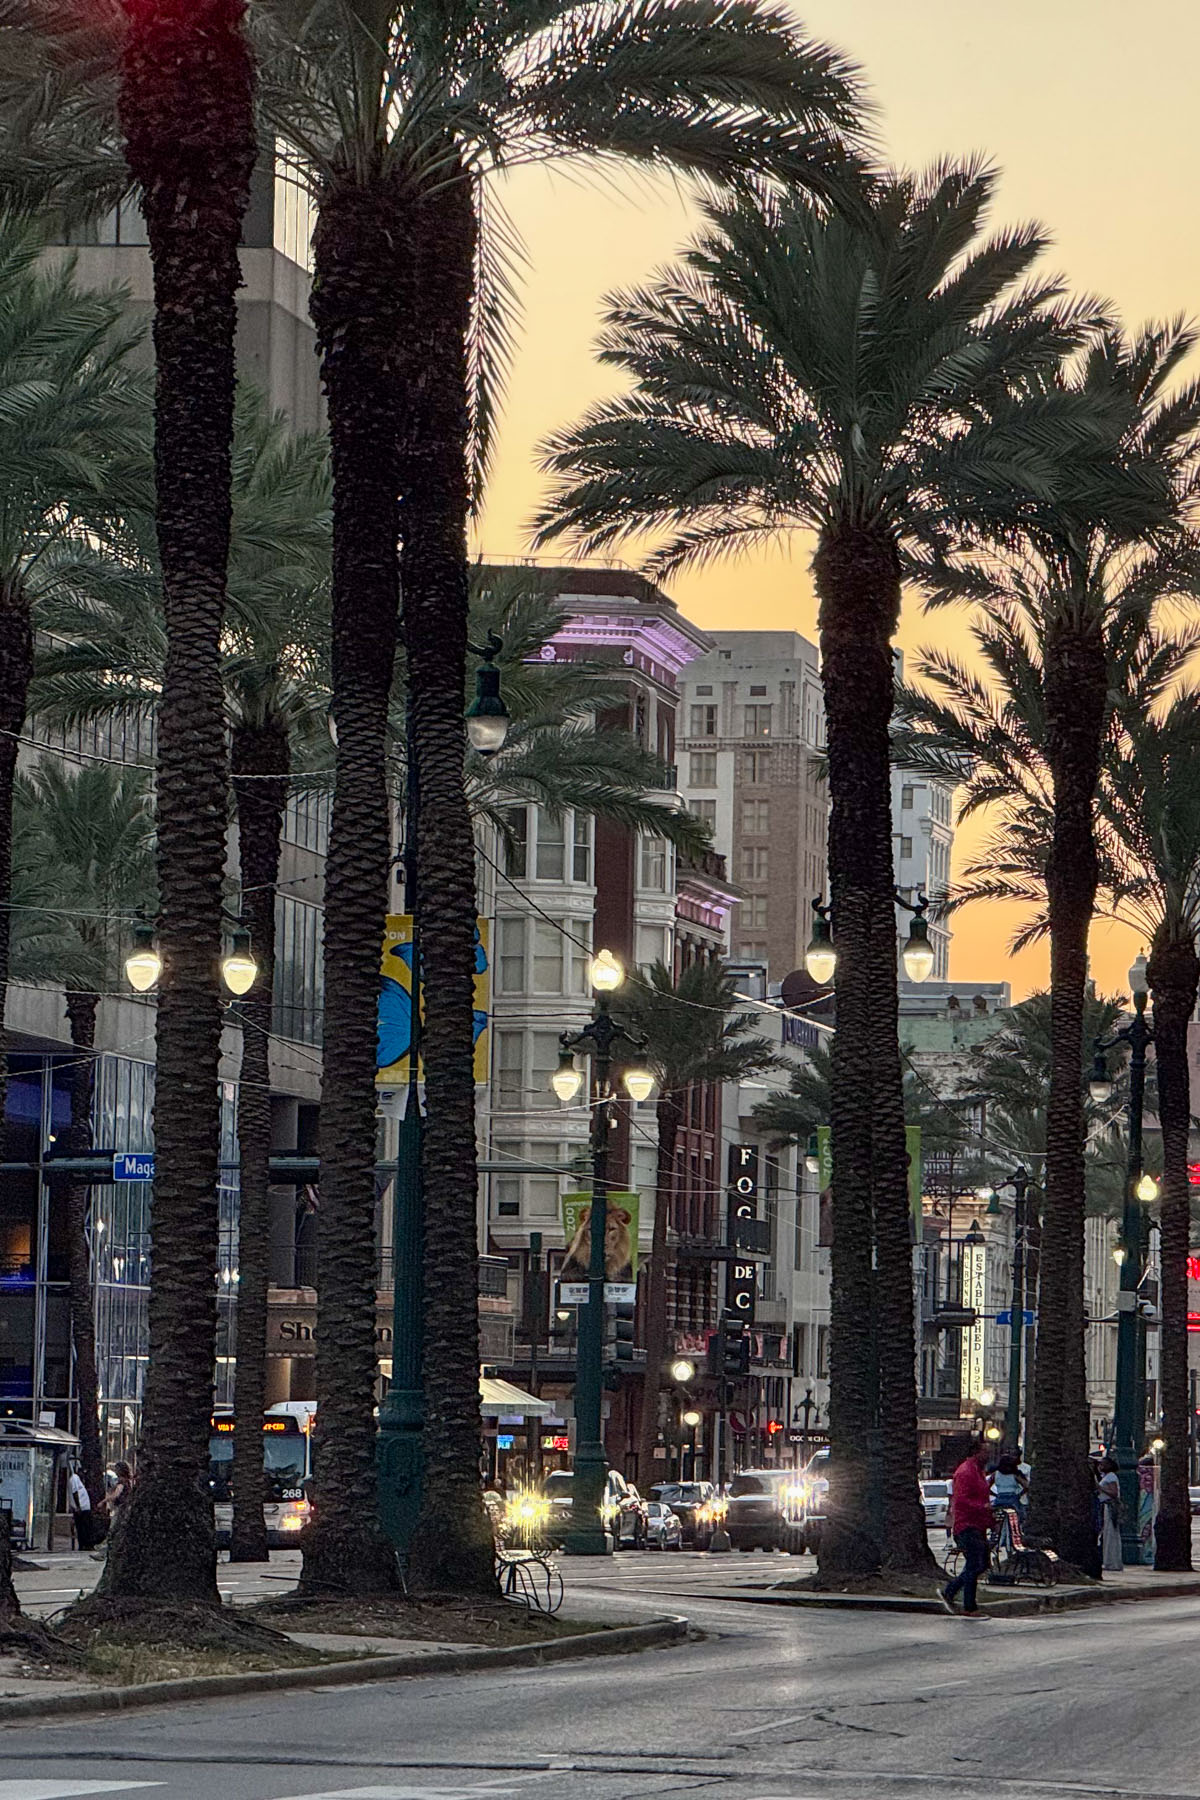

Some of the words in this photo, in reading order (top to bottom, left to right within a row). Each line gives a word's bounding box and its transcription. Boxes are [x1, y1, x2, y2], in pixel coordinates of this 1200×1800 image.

[565, 1207, 576, 1231] ZOO
[734, 1266, 753, 1279] DE
[974, 1253, 983, 1352] ESTABLISHED
[282, 1488, 302, 1498] 268
